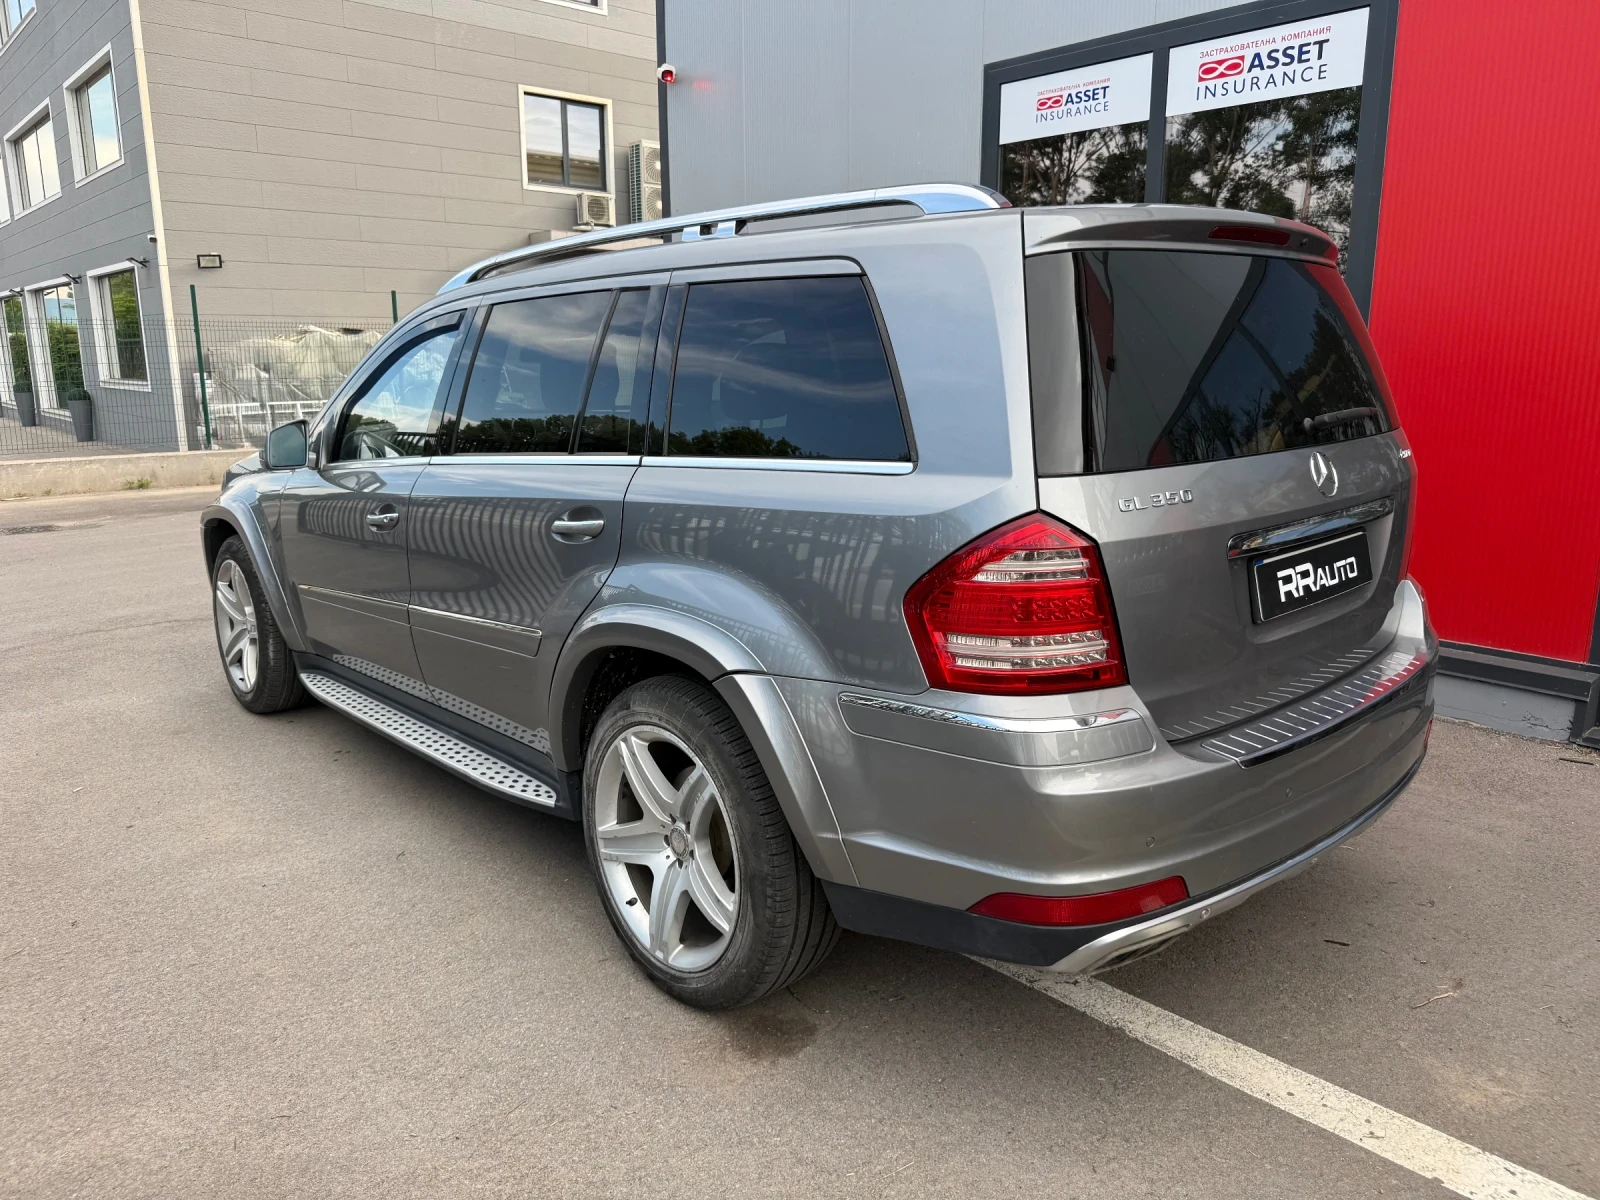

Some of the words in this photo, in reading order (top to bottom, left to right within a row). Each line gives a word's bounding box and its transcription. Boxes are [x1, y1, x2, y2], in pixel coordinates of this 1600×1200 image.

[1199, 37, 1277, 59] ЗАСТРАХОВАТЕЛНА
[1281, 26, 1332, 43] КОМПАНИЯ
[1247, 38, 1330, 73] ASSET
[1064, 85, 1110, 106] ASSET
[1196, 63, 1328, 101] INSURANCE
[1035, 101, 1109, 123] INSURANCE
[1118, 496, 1149, 512] GL
[1150, 489, 1194, 507] 350
